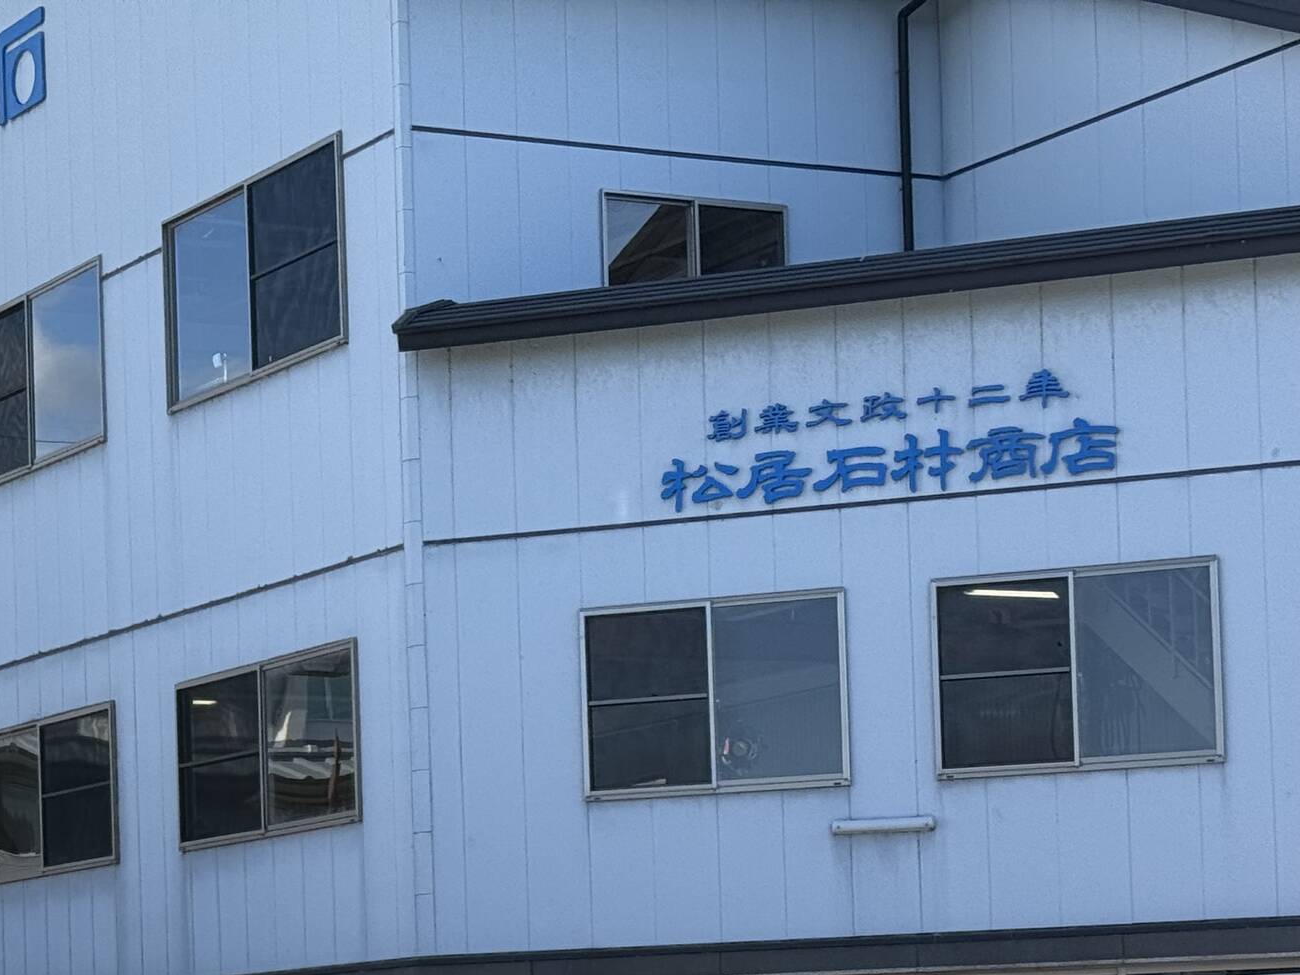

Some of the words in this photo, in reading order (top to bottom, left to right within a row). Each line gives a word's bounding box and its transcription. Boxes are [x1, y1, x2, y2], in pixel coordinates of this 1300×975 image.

[707, 368, 1071, 442] 創業文政十二年
